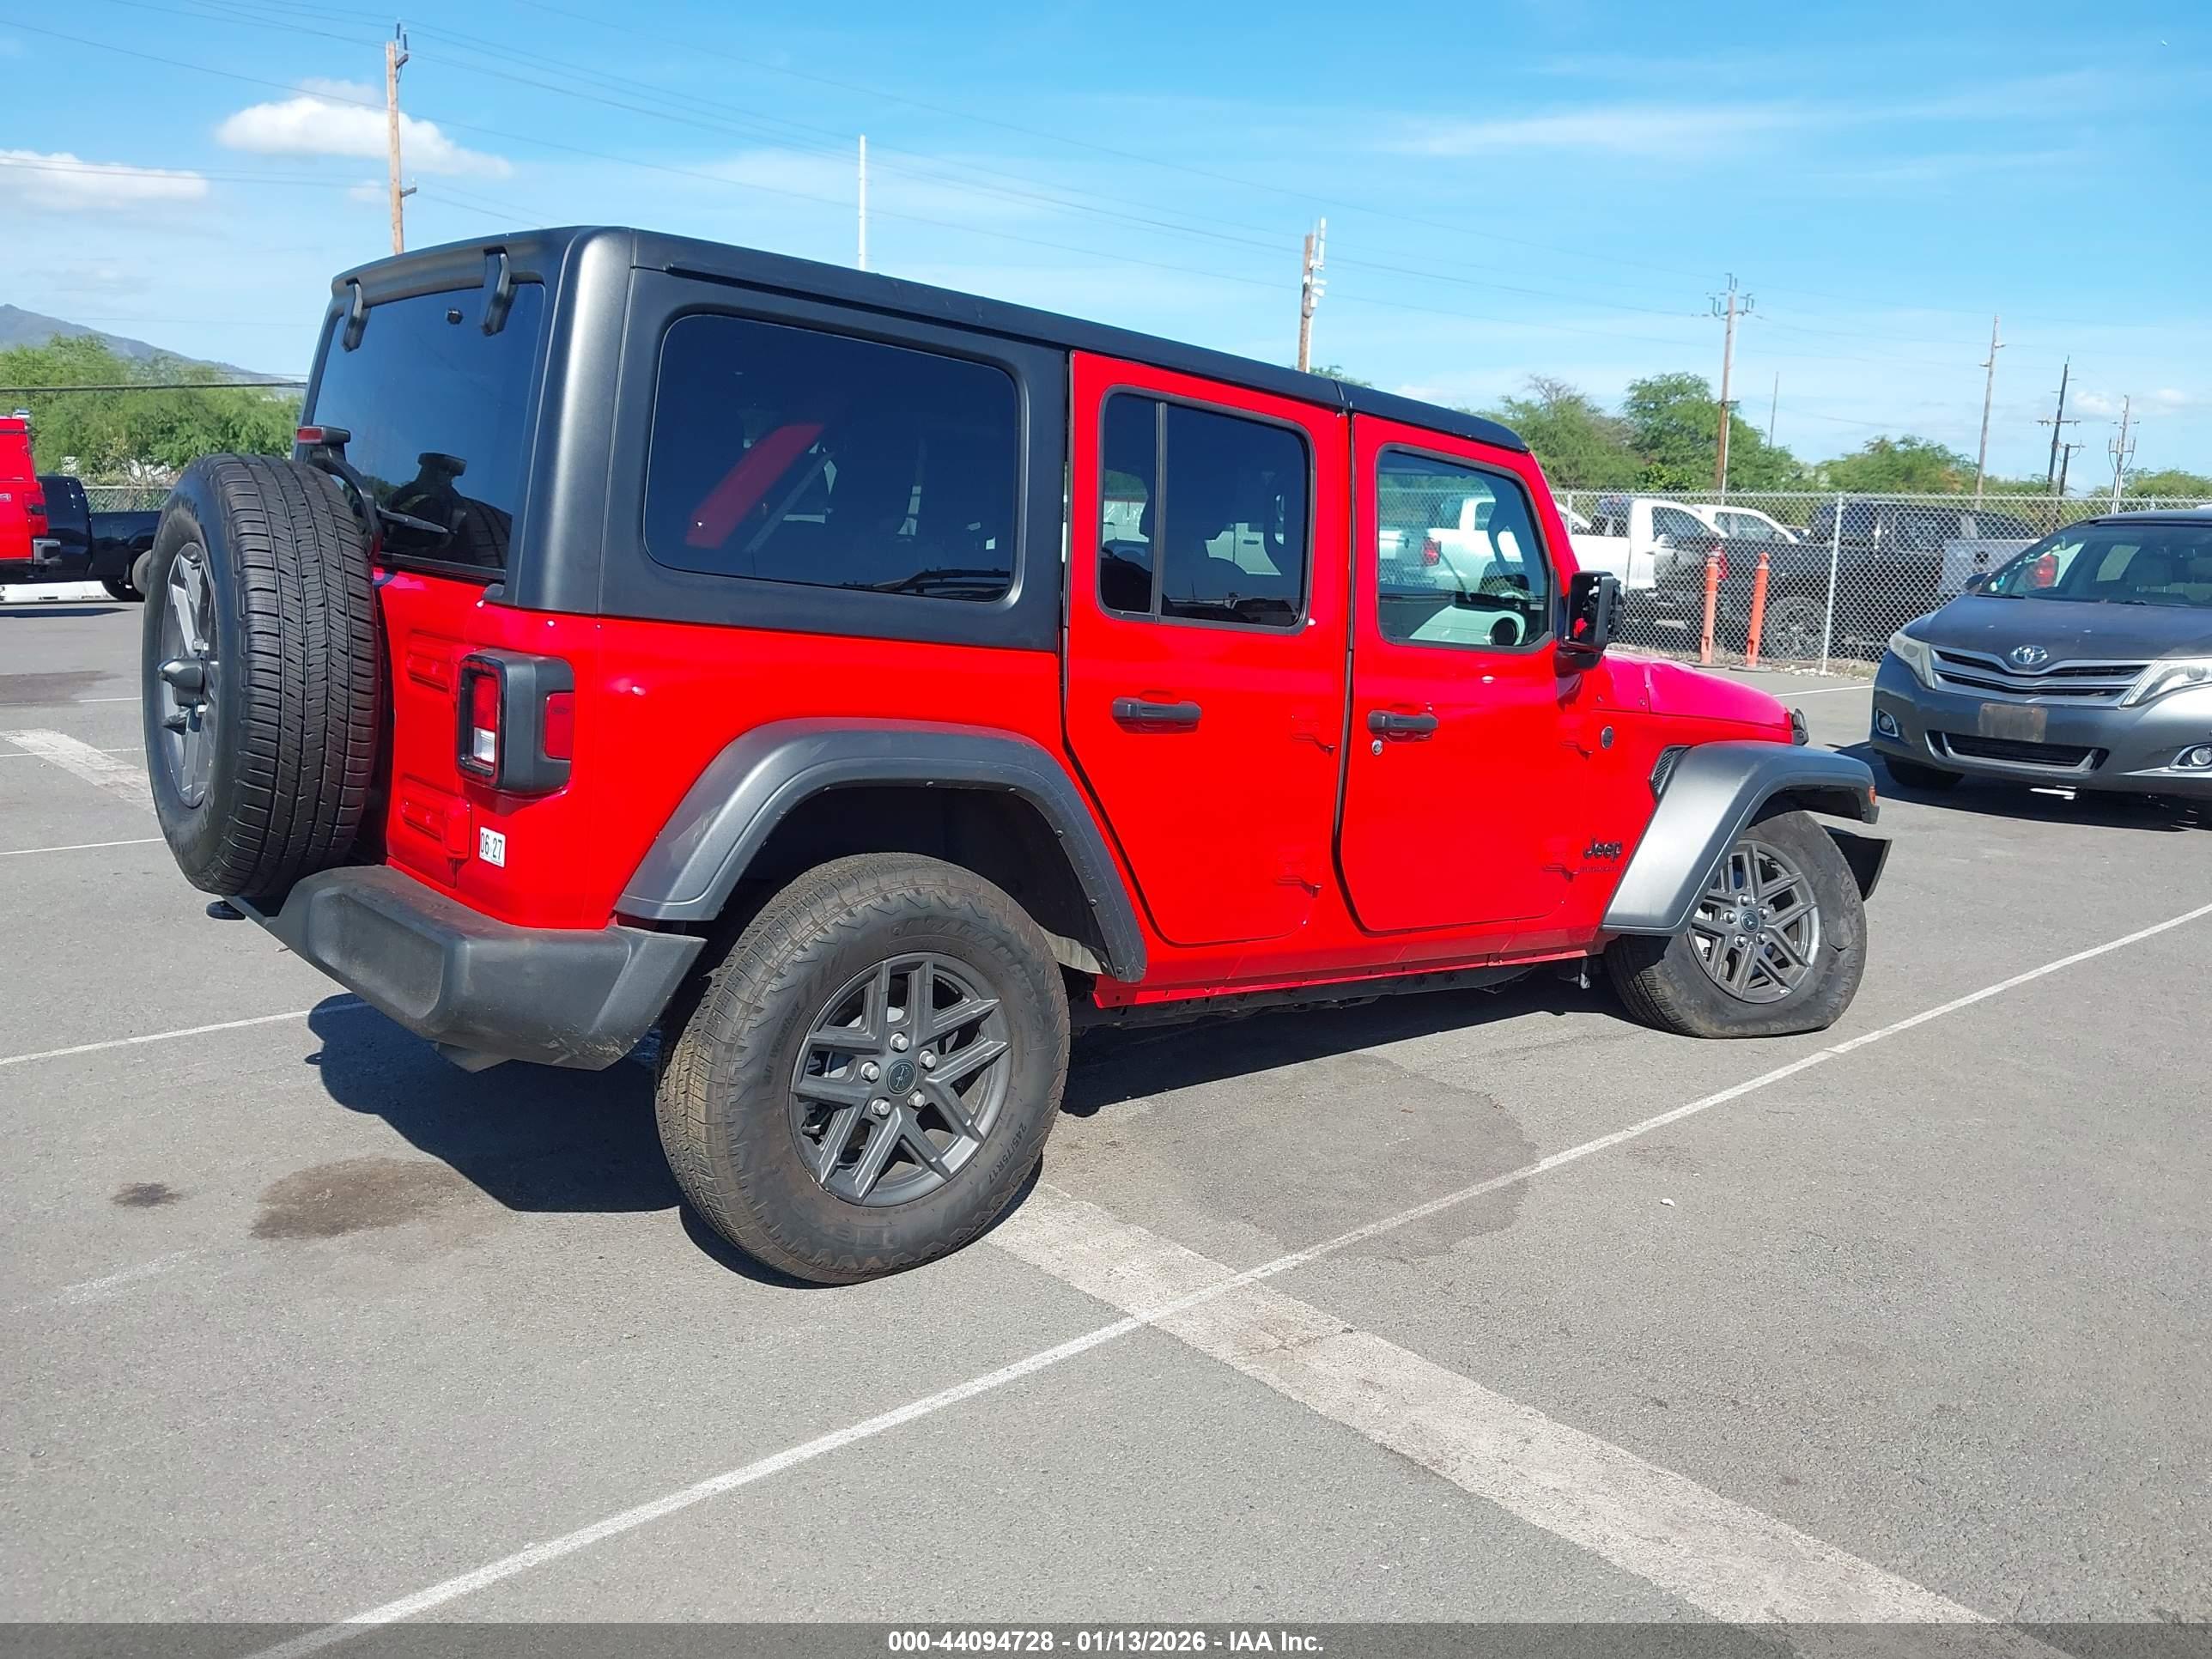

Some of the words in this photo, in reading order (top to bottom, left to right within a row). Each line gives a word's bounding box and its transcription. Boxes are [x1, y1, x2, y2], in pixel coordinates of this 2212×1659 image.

[492, 837, 503, 860] 27
[1583, 838, 1622, 863] Jeep
[988, 1121, 1027, 1183] 245/75R17
